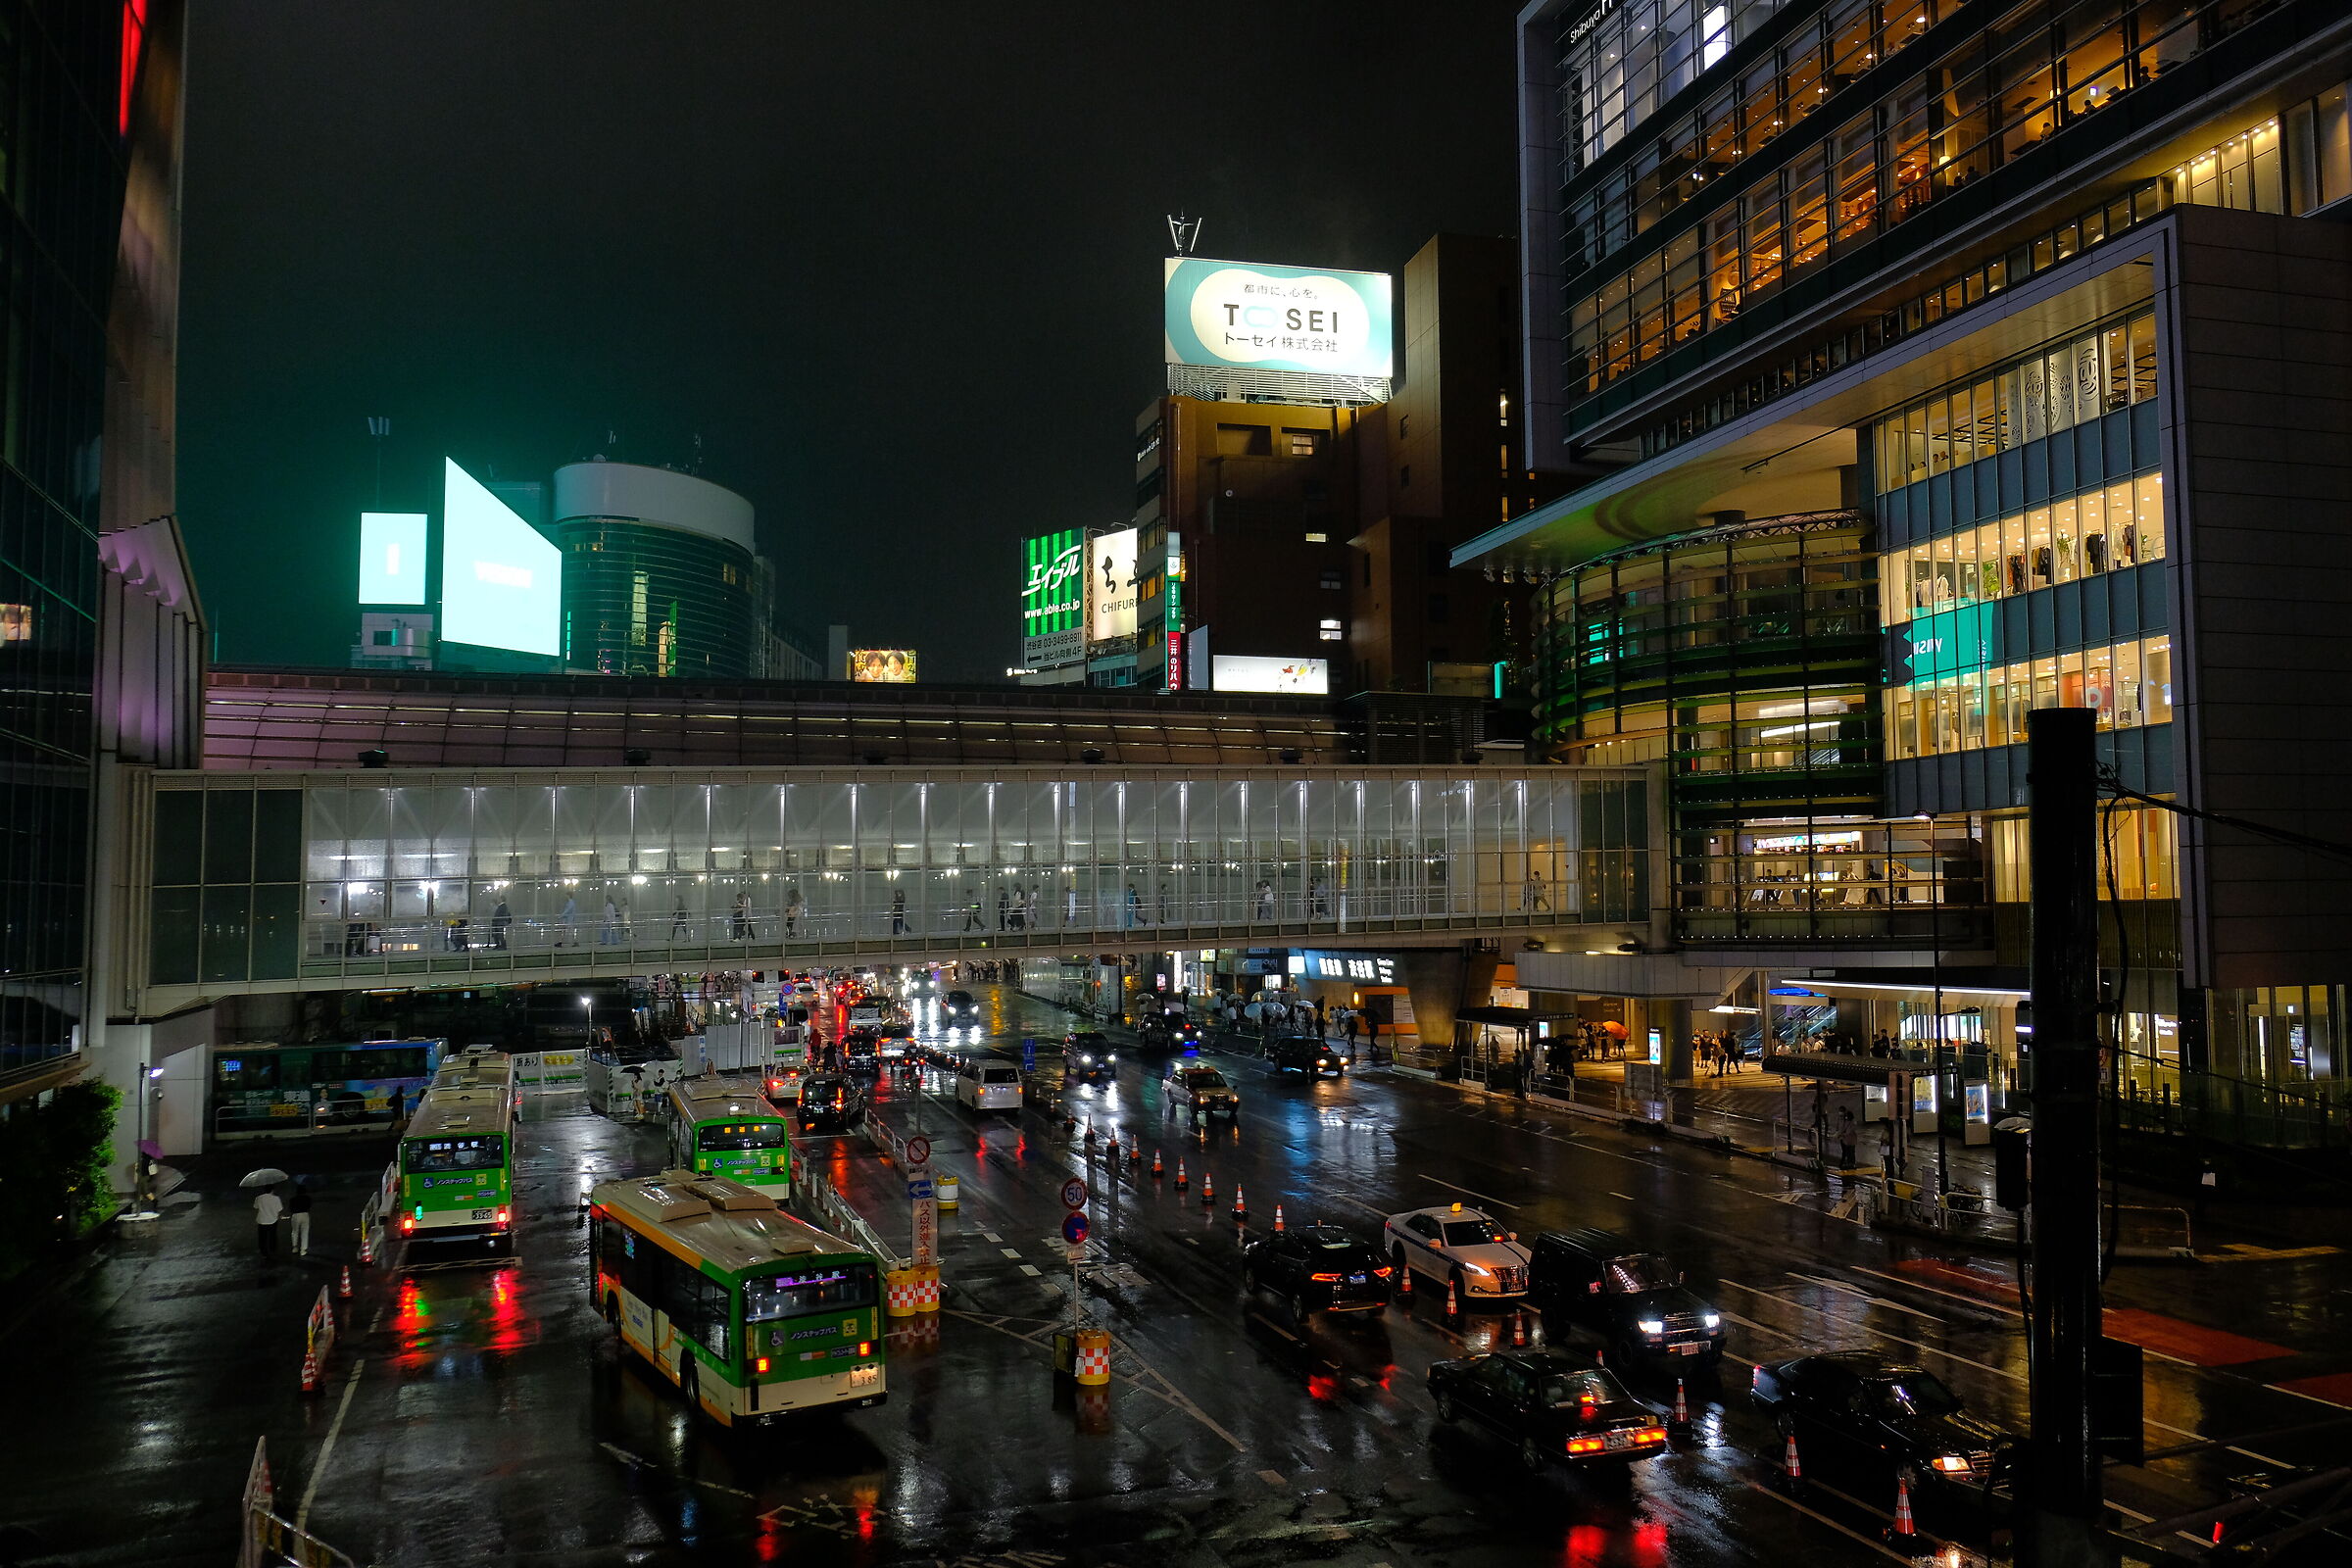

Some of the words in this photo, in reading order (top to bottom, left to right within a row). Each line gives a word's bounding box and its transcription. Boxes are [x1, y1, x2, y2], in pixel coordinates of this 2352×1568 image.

[1570, 8, 1600, 44] Shibuya
[1244, 283, 1318, 300] 都市に、心を。
[1225, 331, 1338, 353] トーセイ株式会社
[1021, 545, 1081, 596] エイブル
[1024, 598, 1081, 619] www.able.co.jp
[1026, 638, 1043, 651] 渋谷店
[1044, 632, 1082, 648] 03-3499-8911
[437, 1177, 473, 1186] ノンステップバス
[1067, 1186, 1083, 1202] 50
[918, 1200, 931, 1265] バス以外進入禁止
[790, 1326, 838, 1341] ノンステップバス
